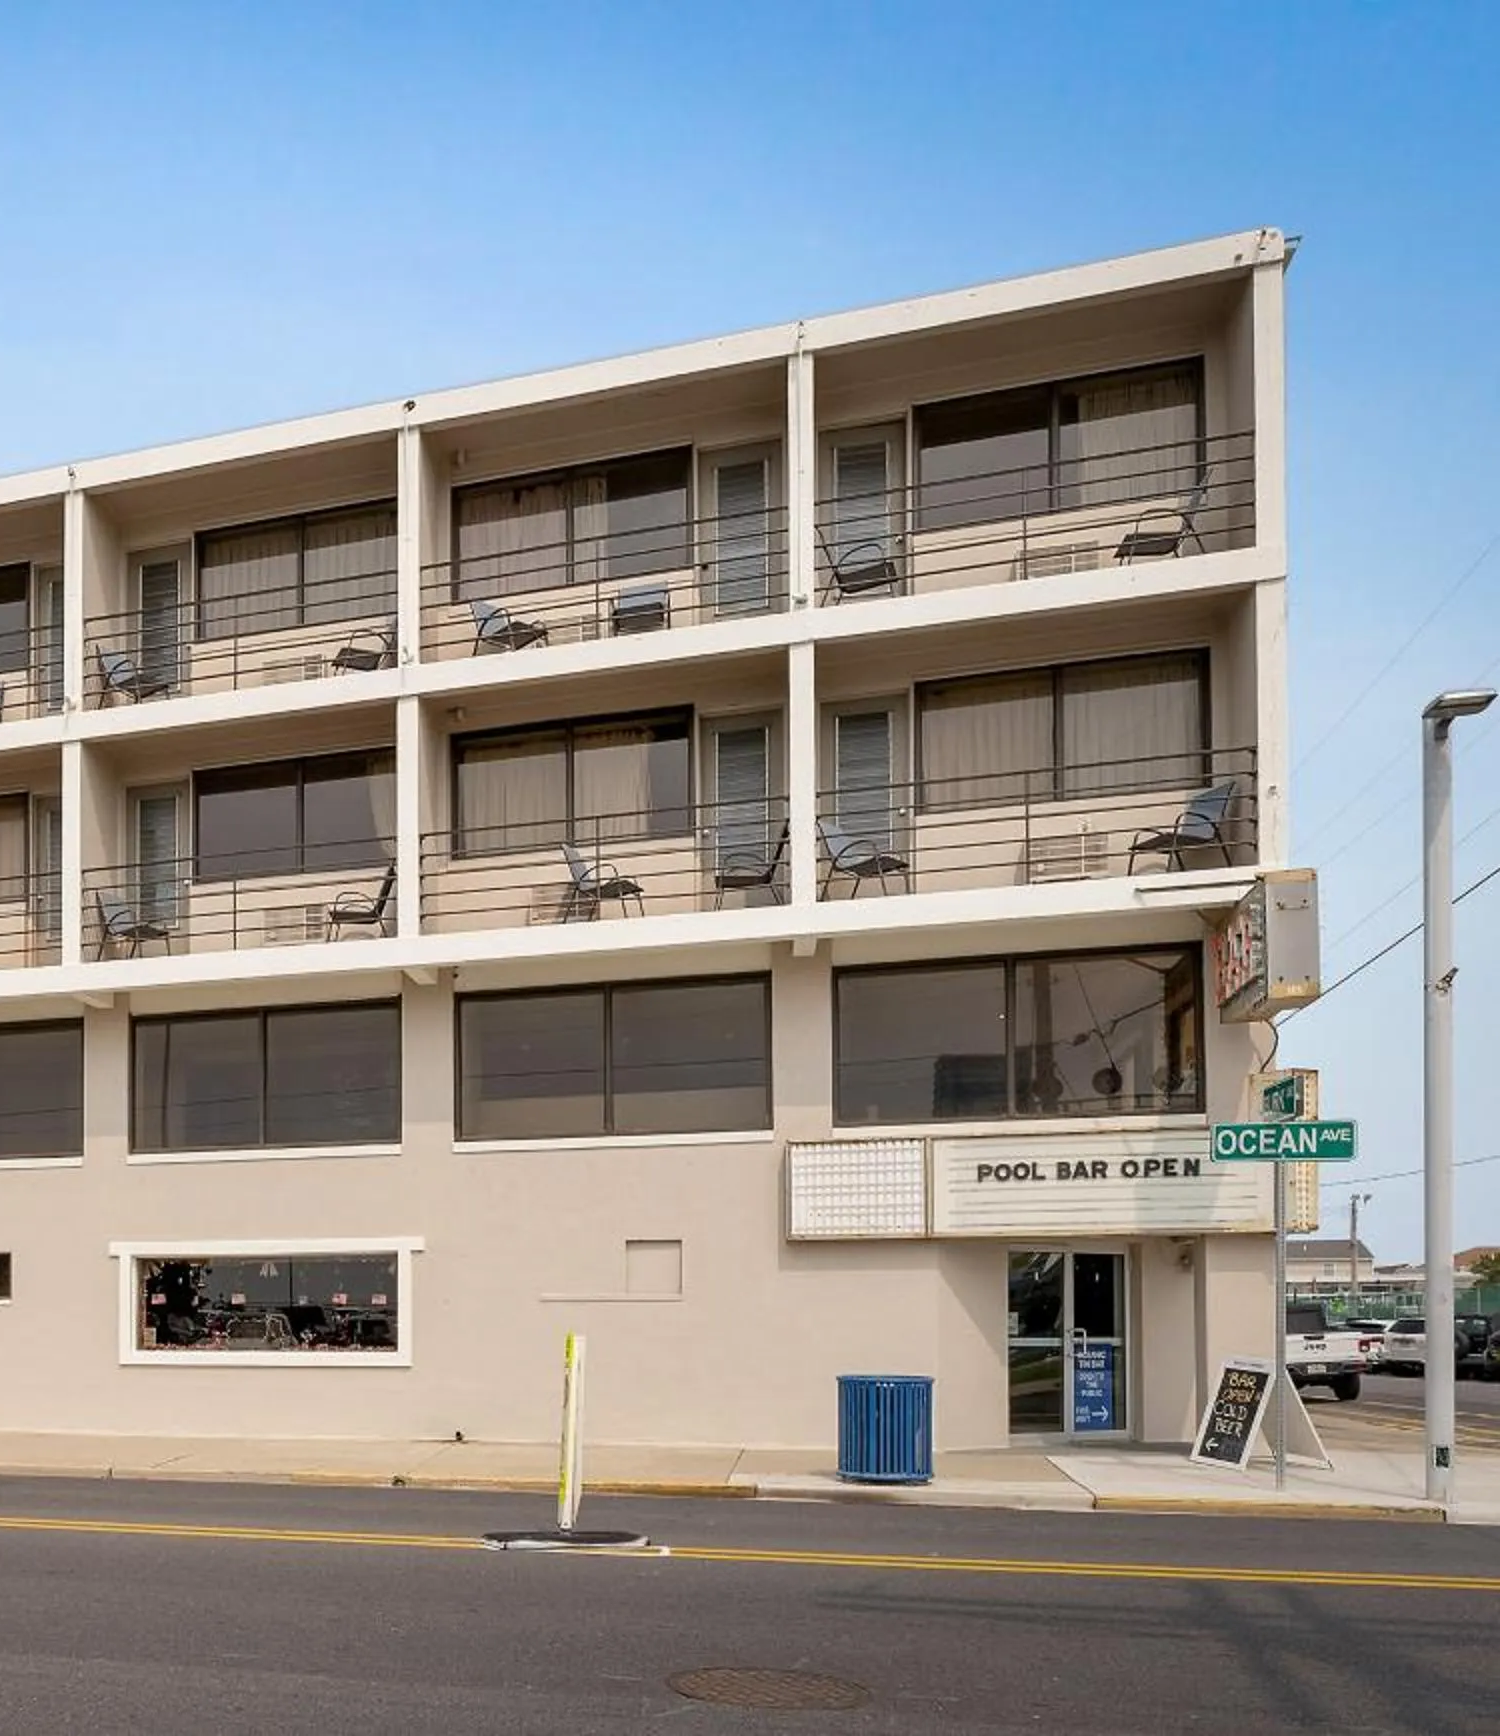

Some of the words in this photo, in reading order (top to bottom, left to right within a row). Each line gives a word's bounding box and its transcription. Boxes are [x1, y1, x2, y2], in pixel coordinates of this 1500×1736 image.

[1217, 1128, 1317, 1155] OCEAN
[1319, 1129, 1351, 1142] AVE
[977, 1162, 1046, 1183] POOL
[1057, 1160, 1109, 1180] BAR
[1120, 1158, 1201, 1178] OPEN
